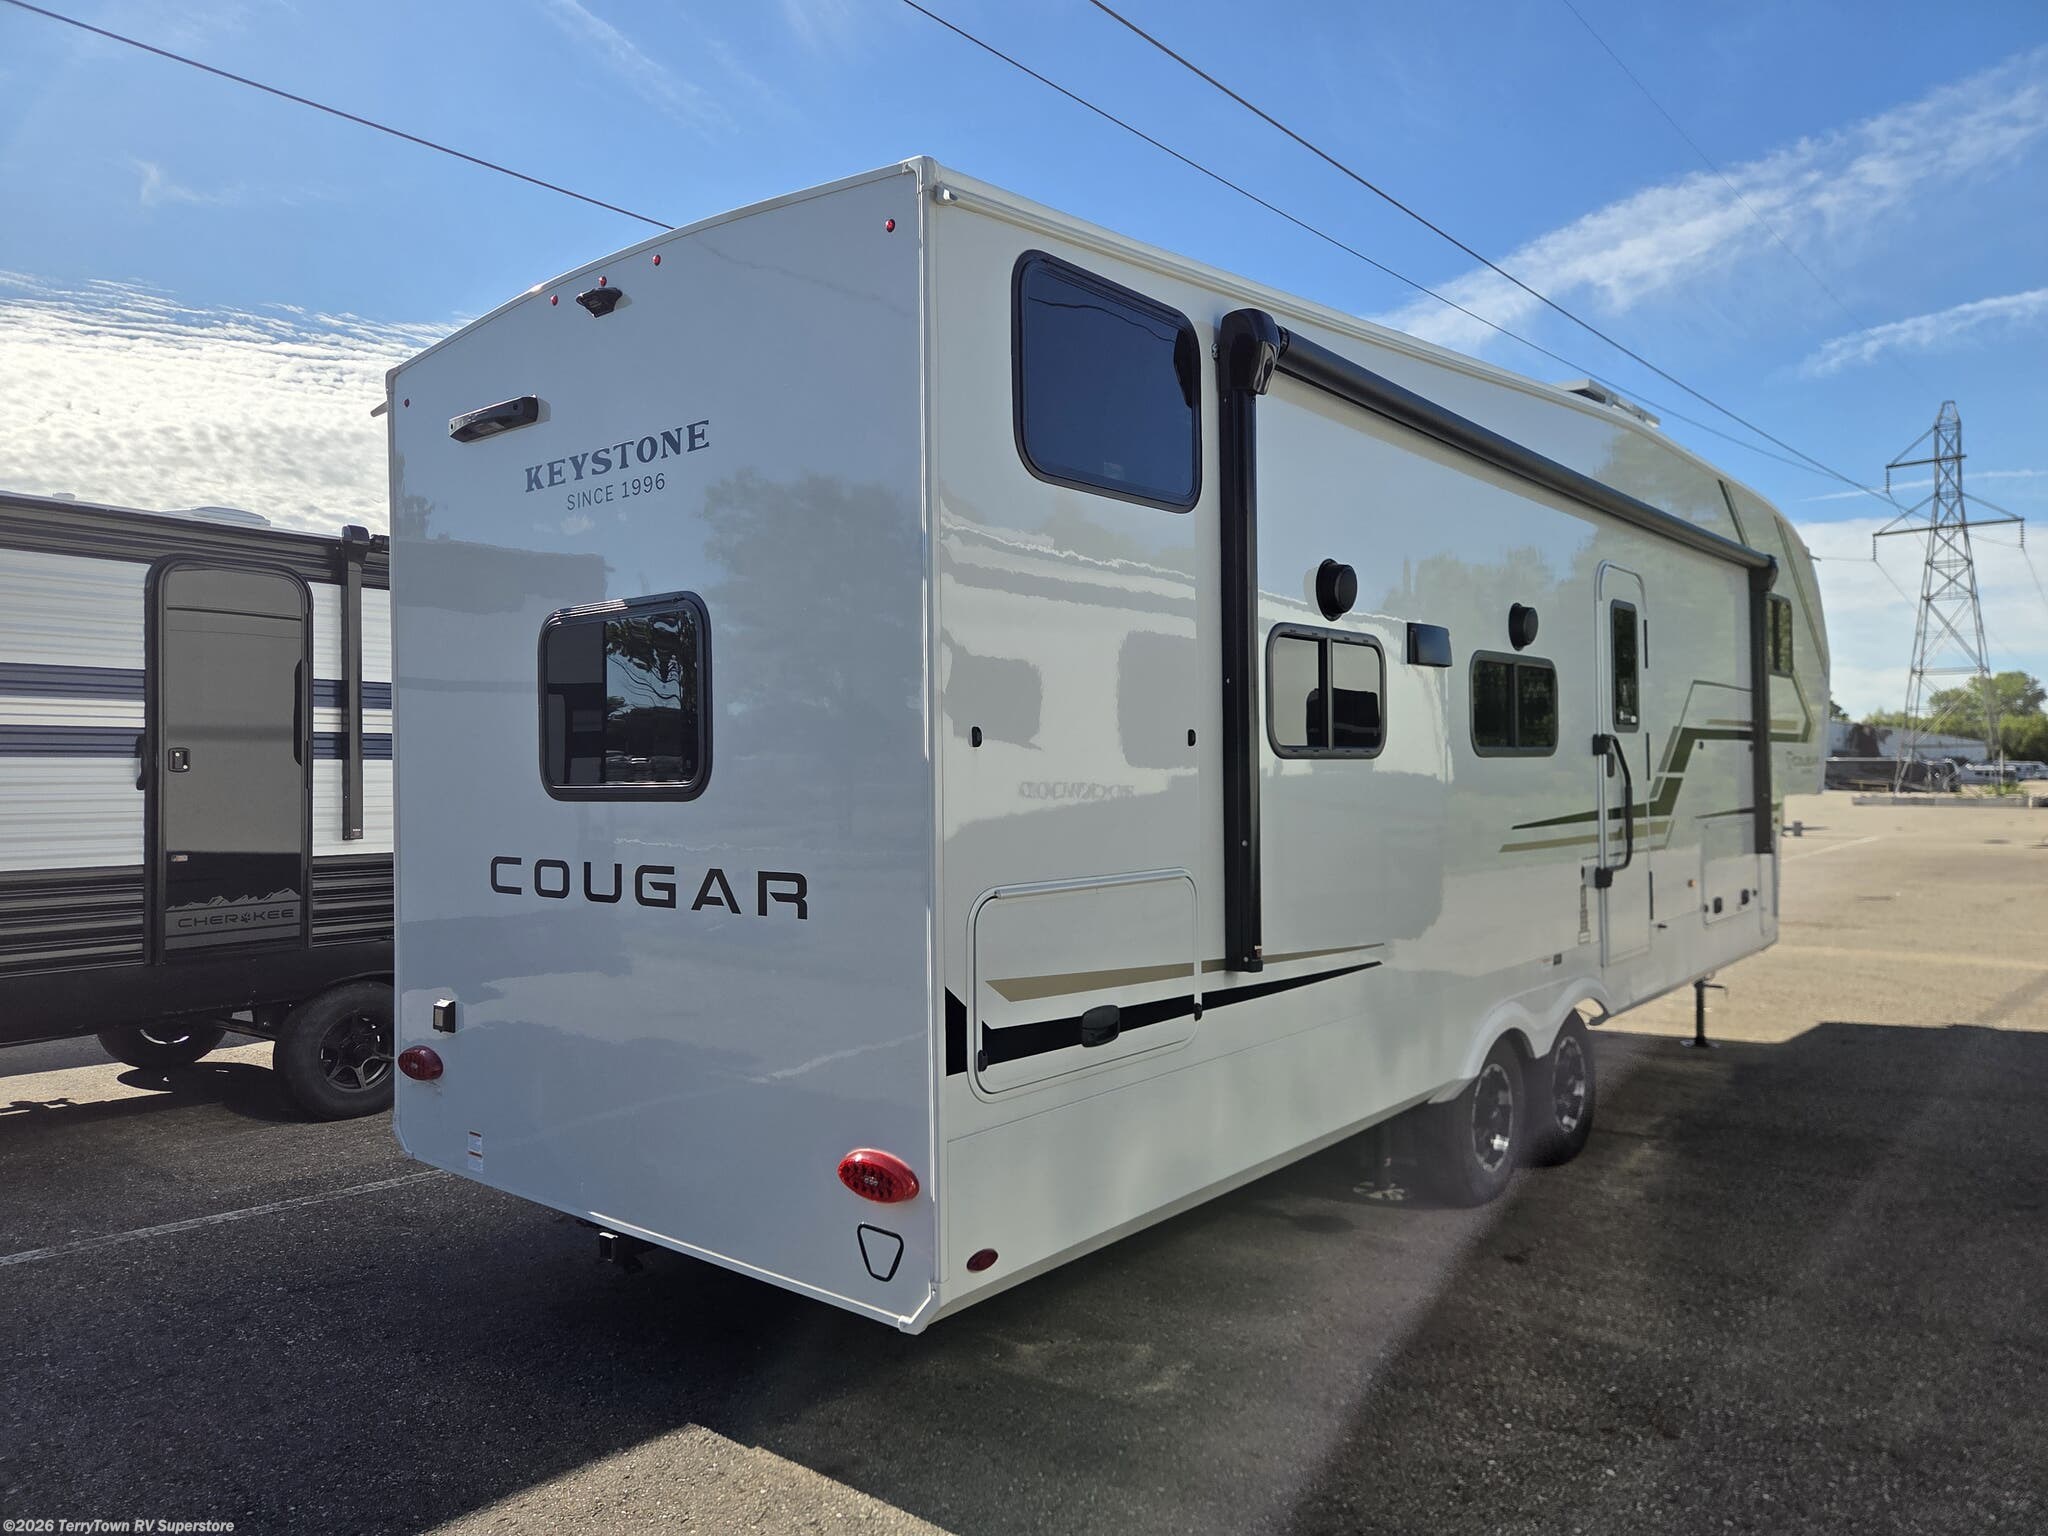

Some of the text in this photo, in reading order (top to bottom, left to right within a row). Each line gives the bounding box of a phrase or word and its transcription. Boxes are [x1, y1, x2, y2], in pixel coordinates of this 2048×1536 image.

[525, 420, 710, 493] KEYSTONE
[567, 472, 666, 511] SINCE 1996
[490, 855, 808, 920] COUGAR
